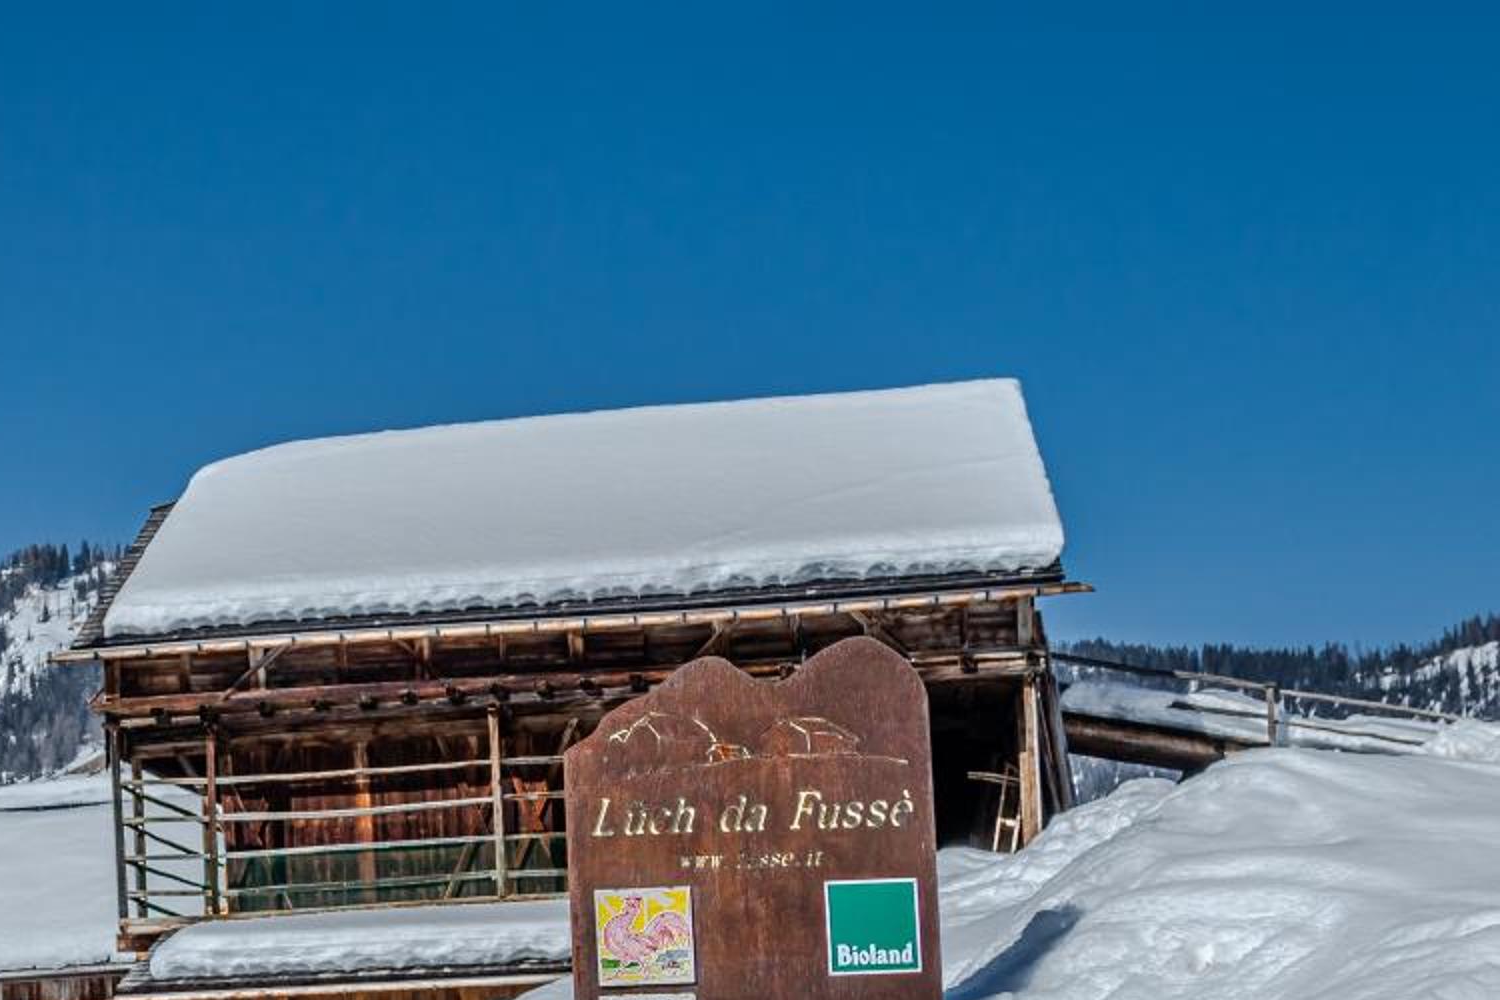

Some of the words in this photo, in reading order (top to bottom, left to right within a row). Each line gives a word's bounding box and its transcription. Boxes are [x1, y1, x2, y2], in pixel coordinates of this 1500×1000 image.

[719, 795, 768, 832] da
[789, 789, 914, 829] Fussè
[837, 942, 913, 967] Bioland
